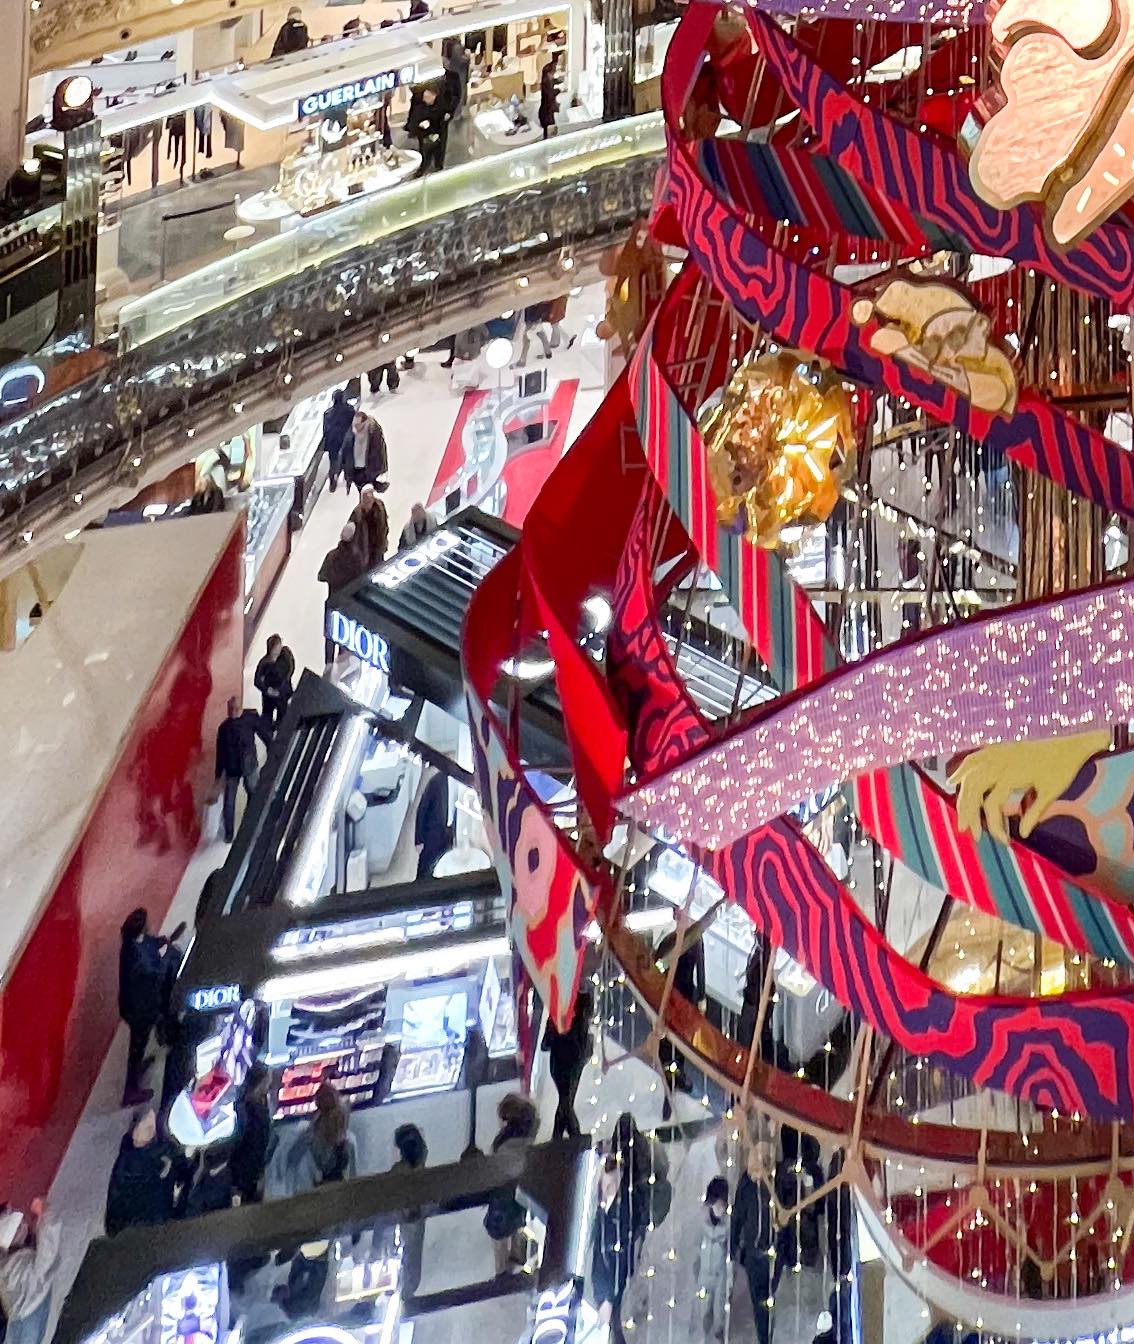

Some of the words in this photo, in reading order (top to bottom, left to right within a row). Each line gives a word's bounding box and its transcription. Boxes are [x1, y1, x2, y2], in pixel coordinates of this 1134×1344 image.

[301, 71, 396, 115] GUERLAIN
[331, 610, 391, 673] DIOR
[194, 983, 241, 1011] DIOR
